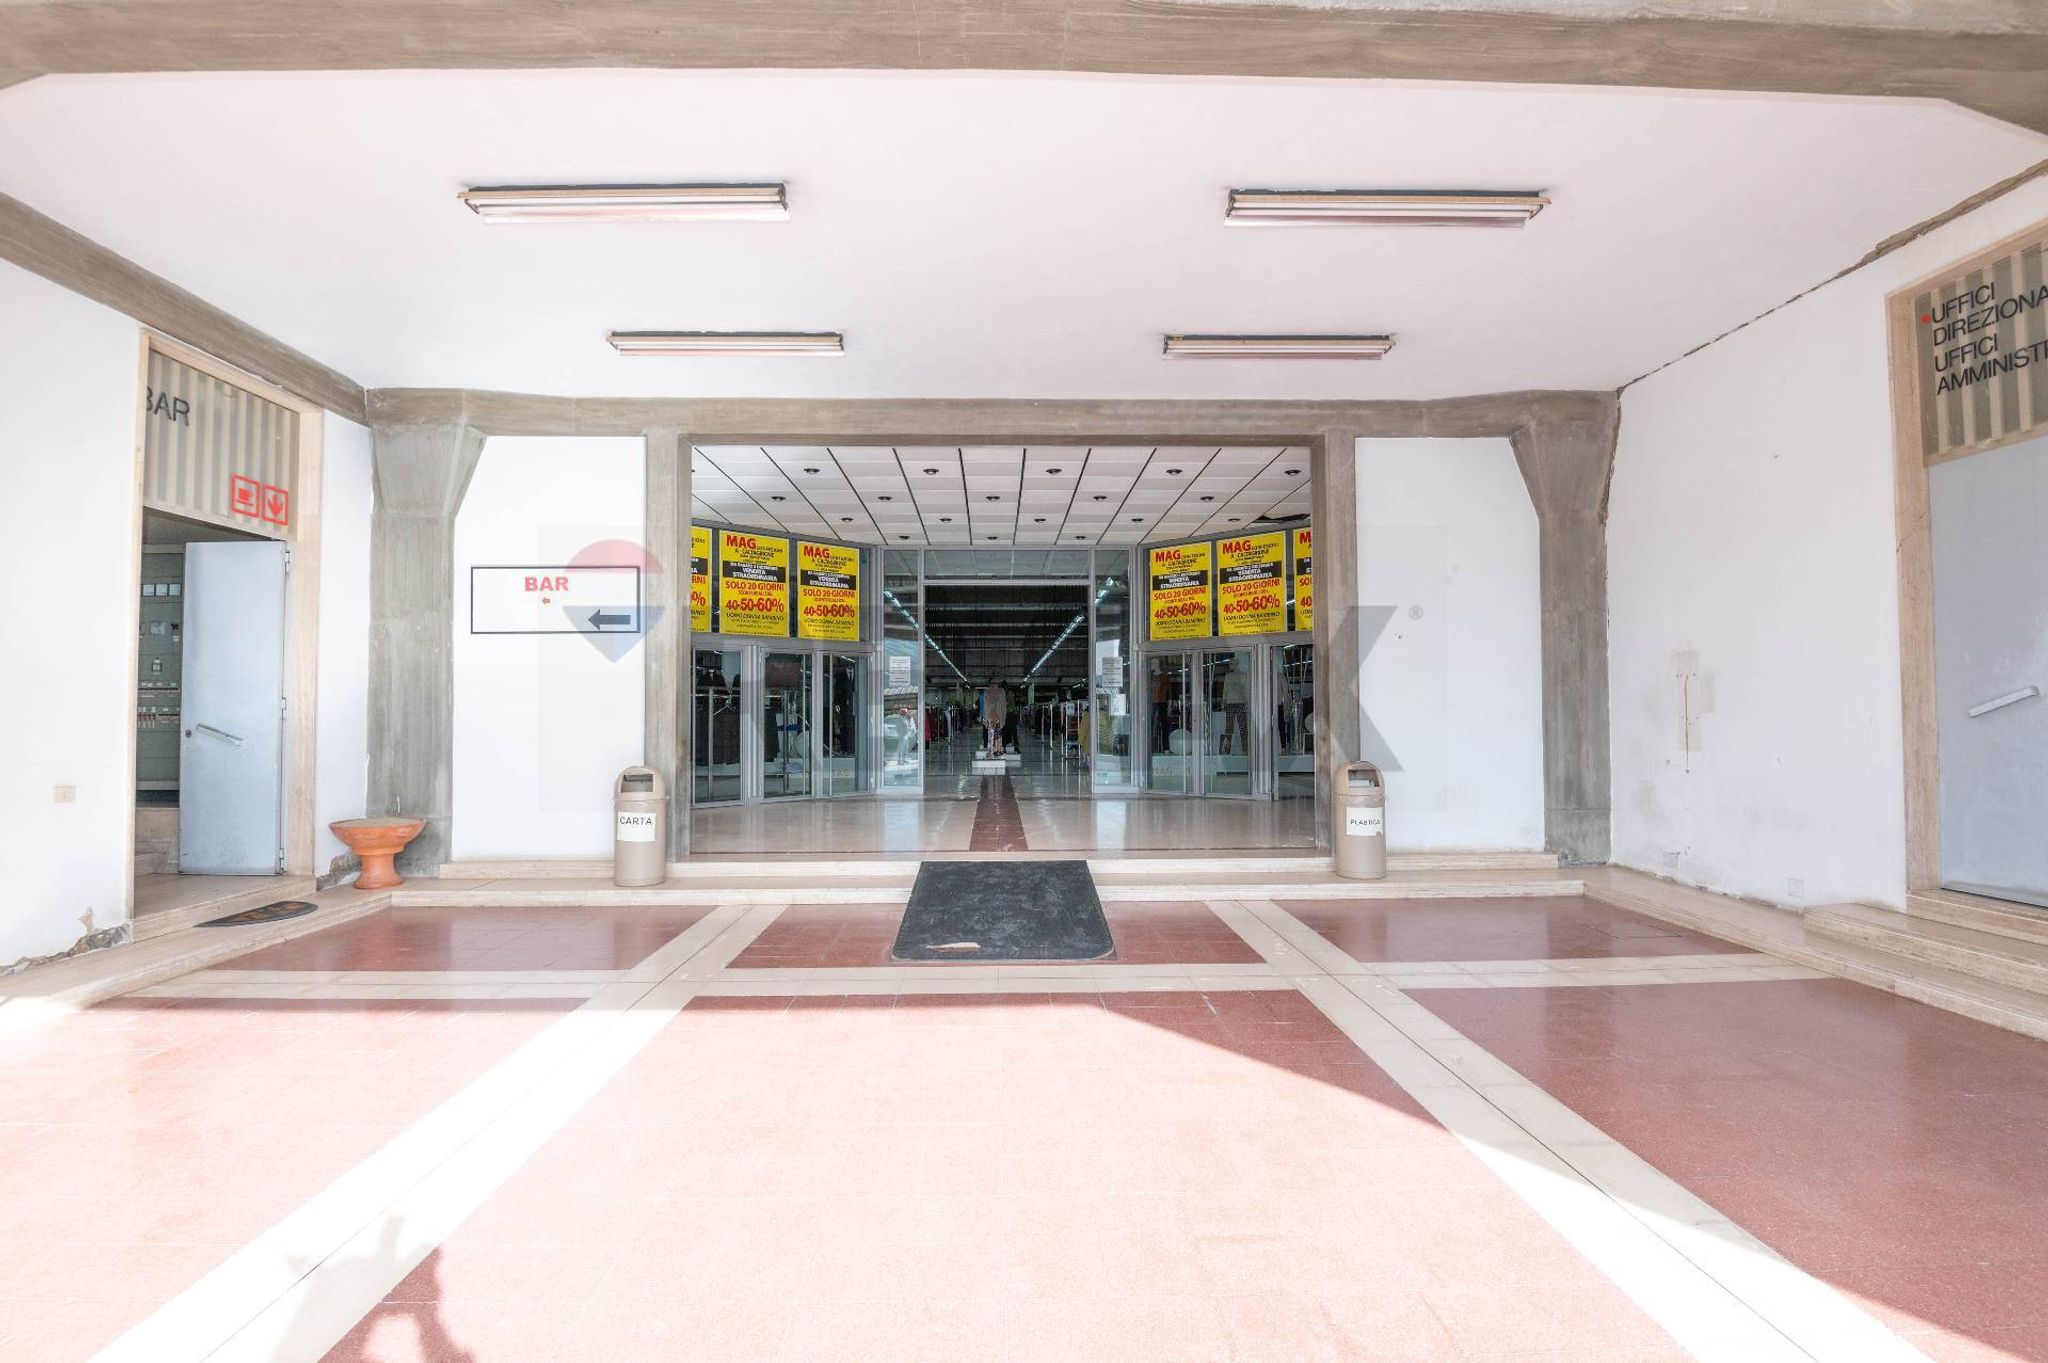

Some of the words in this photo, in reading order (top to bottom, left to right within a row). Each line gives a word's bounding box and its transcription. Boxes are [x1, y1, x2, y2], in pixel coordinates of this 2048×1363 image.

[1931, 282, 1995, 324] UFFICI
[1934, 333, 1998, 372] UFFICI
[726, 534, 756, 550] MAG
[1222, 540, 1252, 554] MAG
[804, 545, 830, 558] MAG
[1155, 550, 1181, 562] MAG
[524, 576, 569, 591] BAR
[725, 581, 746, 589] SOLO
[758, 583, 784, 592] GIORNI
[1222, 585, 1241, 595] SOLO
[1243, 582, 1252, 591] 20
[1253, 579, 1280, 589] GIORNI
[803, 589, 821, 597] SOLO
[1154, 592, 1172, 600] SOLO
[1173, 590, 1181, 598] 20
[1182, 586, 1206, 596] GIORNI
[726, 598, 784, 613] 40-50-60%
[804, 604, 855, 618] 40-50-60%
[1154, 601, 1206, 619] 40-50-60%
[1223, 594, 1280, 614] 40-50-60%
[620, 816, 652, 825] CARTA
